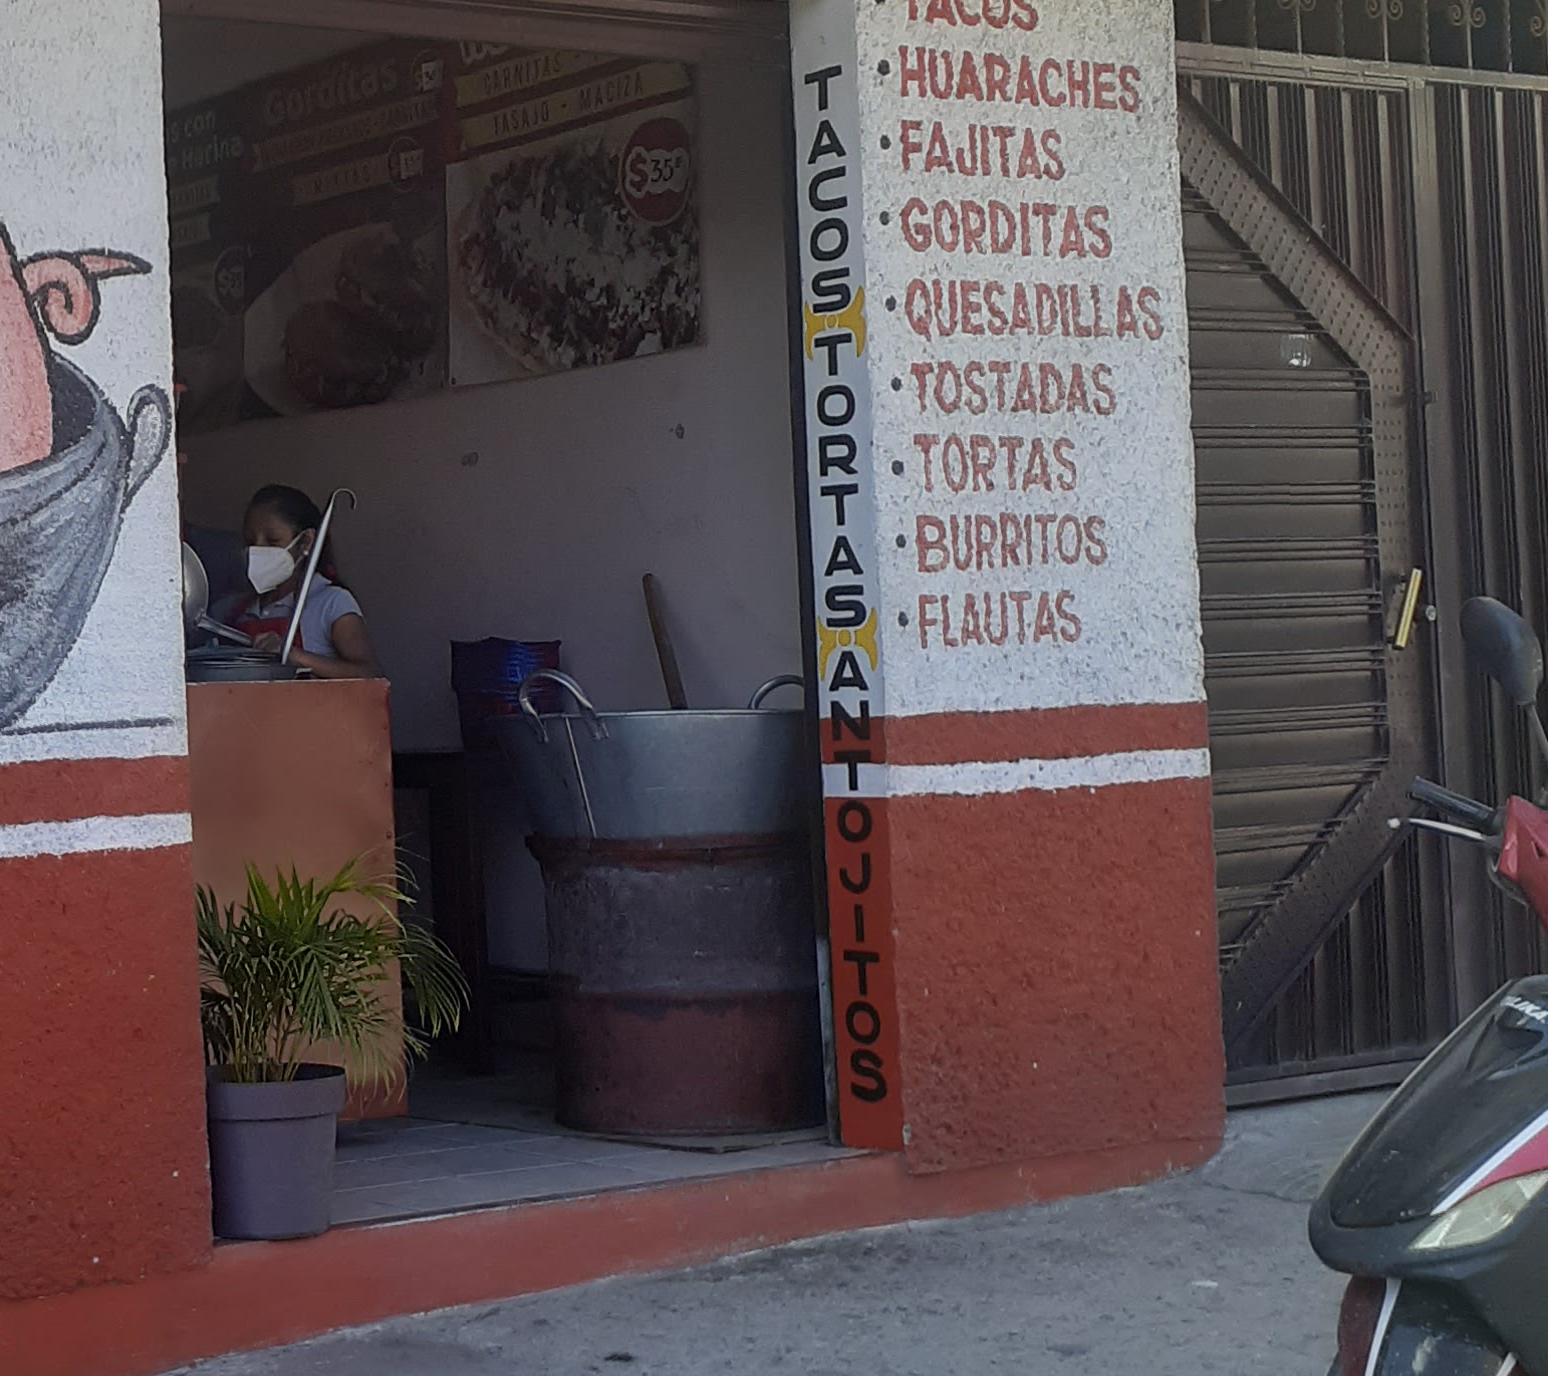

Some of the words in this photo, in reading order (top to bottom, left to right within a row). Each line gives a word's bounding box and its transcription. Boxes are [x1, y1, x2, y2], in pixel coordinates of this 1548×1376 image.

[493, 102, 549, 134] TASAJO
[580, 71, 643, 110] MACIZA
[899, 46, 1140, 113] HUARACHES
[900, 120, 1065, 181] FAJITAS
[804, 65, 851, 314] TACOS
[900, 198, 1112, 259] GORDITAS
[904, 279, 1164, 341] QUESADILLAS
[911, 361, 1117, 415] TOSTADAS
[814, 333, 865, 628] TORTAS
[914, 433, 1077, 493] TORTAS
[915, 514, 1109, 573] BURRITOS
[918, 590, 1082, 649] FLAUTAS
[828, 651, 888, 1103] ANTOJITOS
